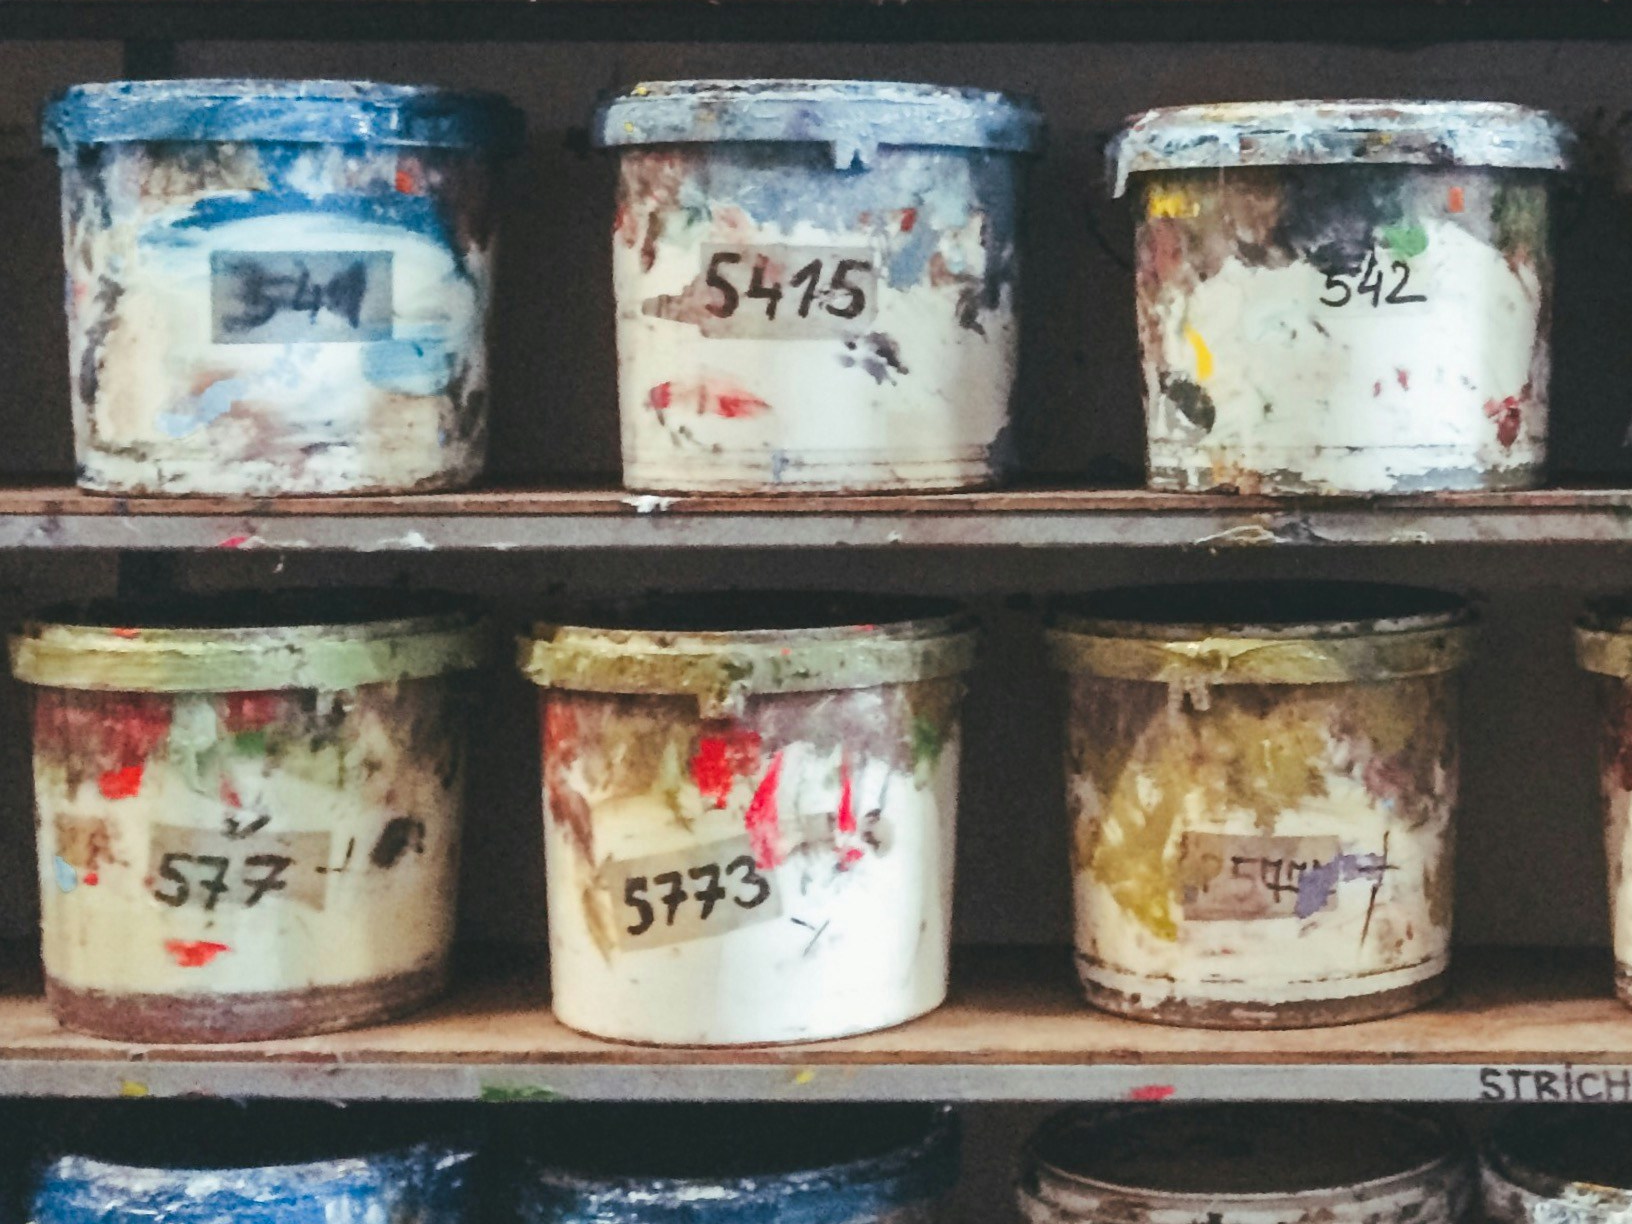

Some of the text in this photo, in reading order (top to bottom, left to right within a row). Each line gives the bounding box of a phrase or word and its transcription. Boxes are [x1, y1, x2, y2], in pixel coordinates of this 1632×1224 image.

[706, 252, 872, 319] 5415
[1319, 256, 1425, 308] 542
[155, 852, 293, 909] 577
[624, 856, 772, 936] 5773
